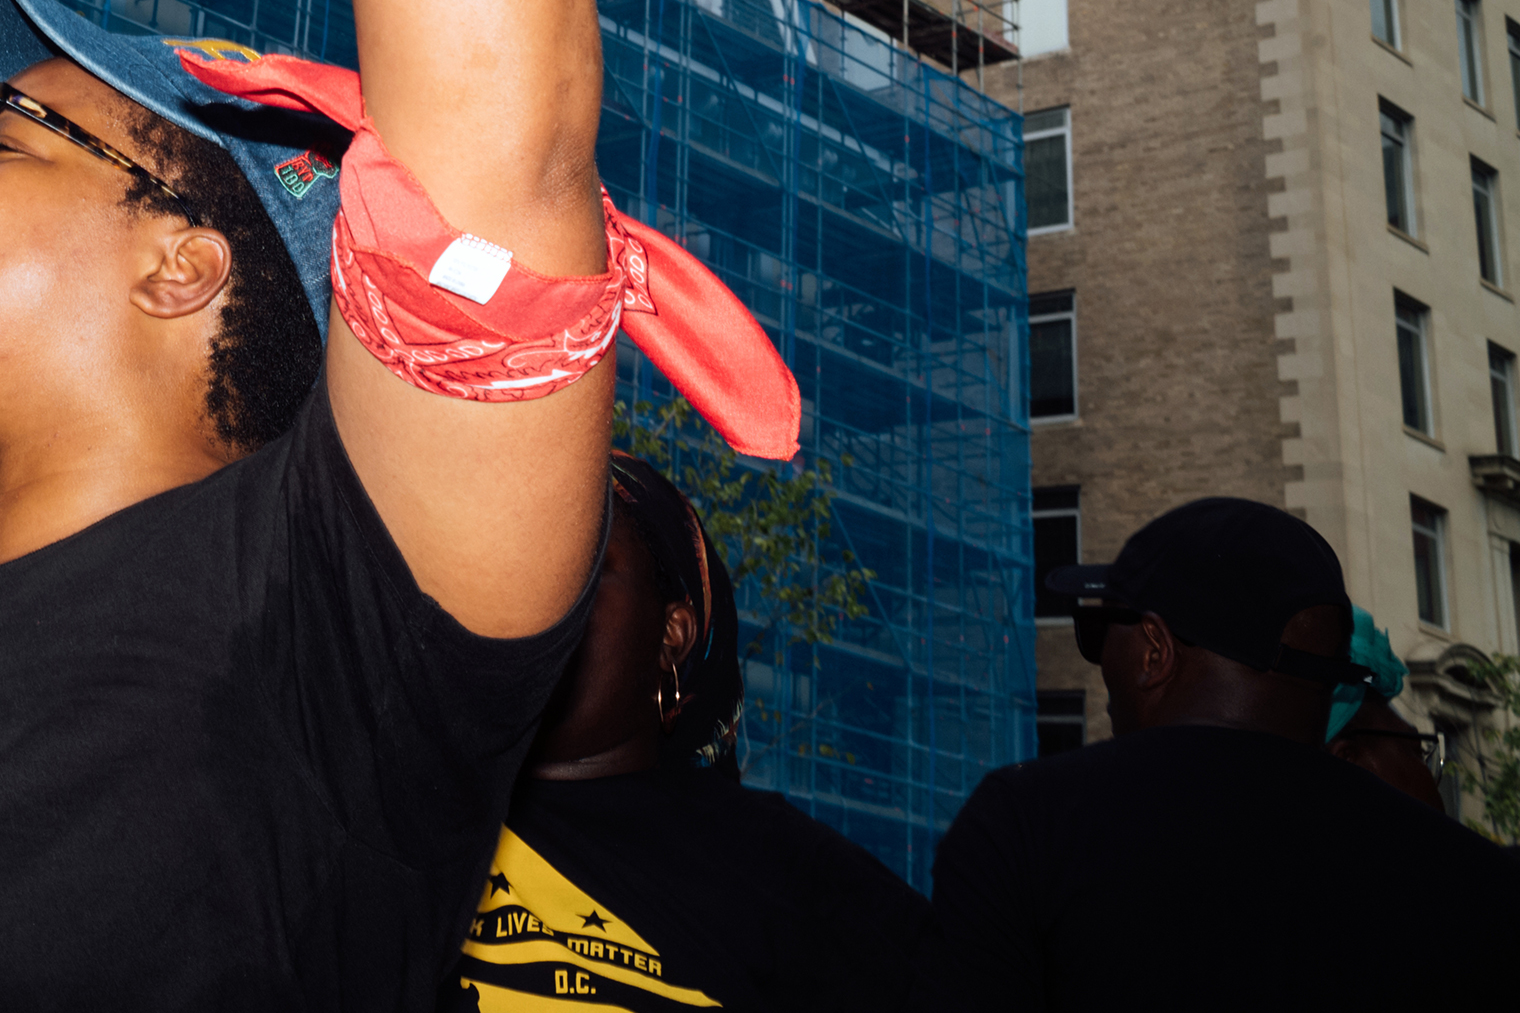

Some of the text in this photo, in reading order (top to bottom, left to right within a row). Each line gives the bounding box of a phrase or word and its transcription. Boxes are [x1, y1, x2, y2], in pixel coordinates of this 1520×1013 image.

[280, 164, 305, 193] 100
[292, 159, 314, 182] BYP
[566, 936, 663, 977] MATTER
[553, 969, 597, 995] D.C.
